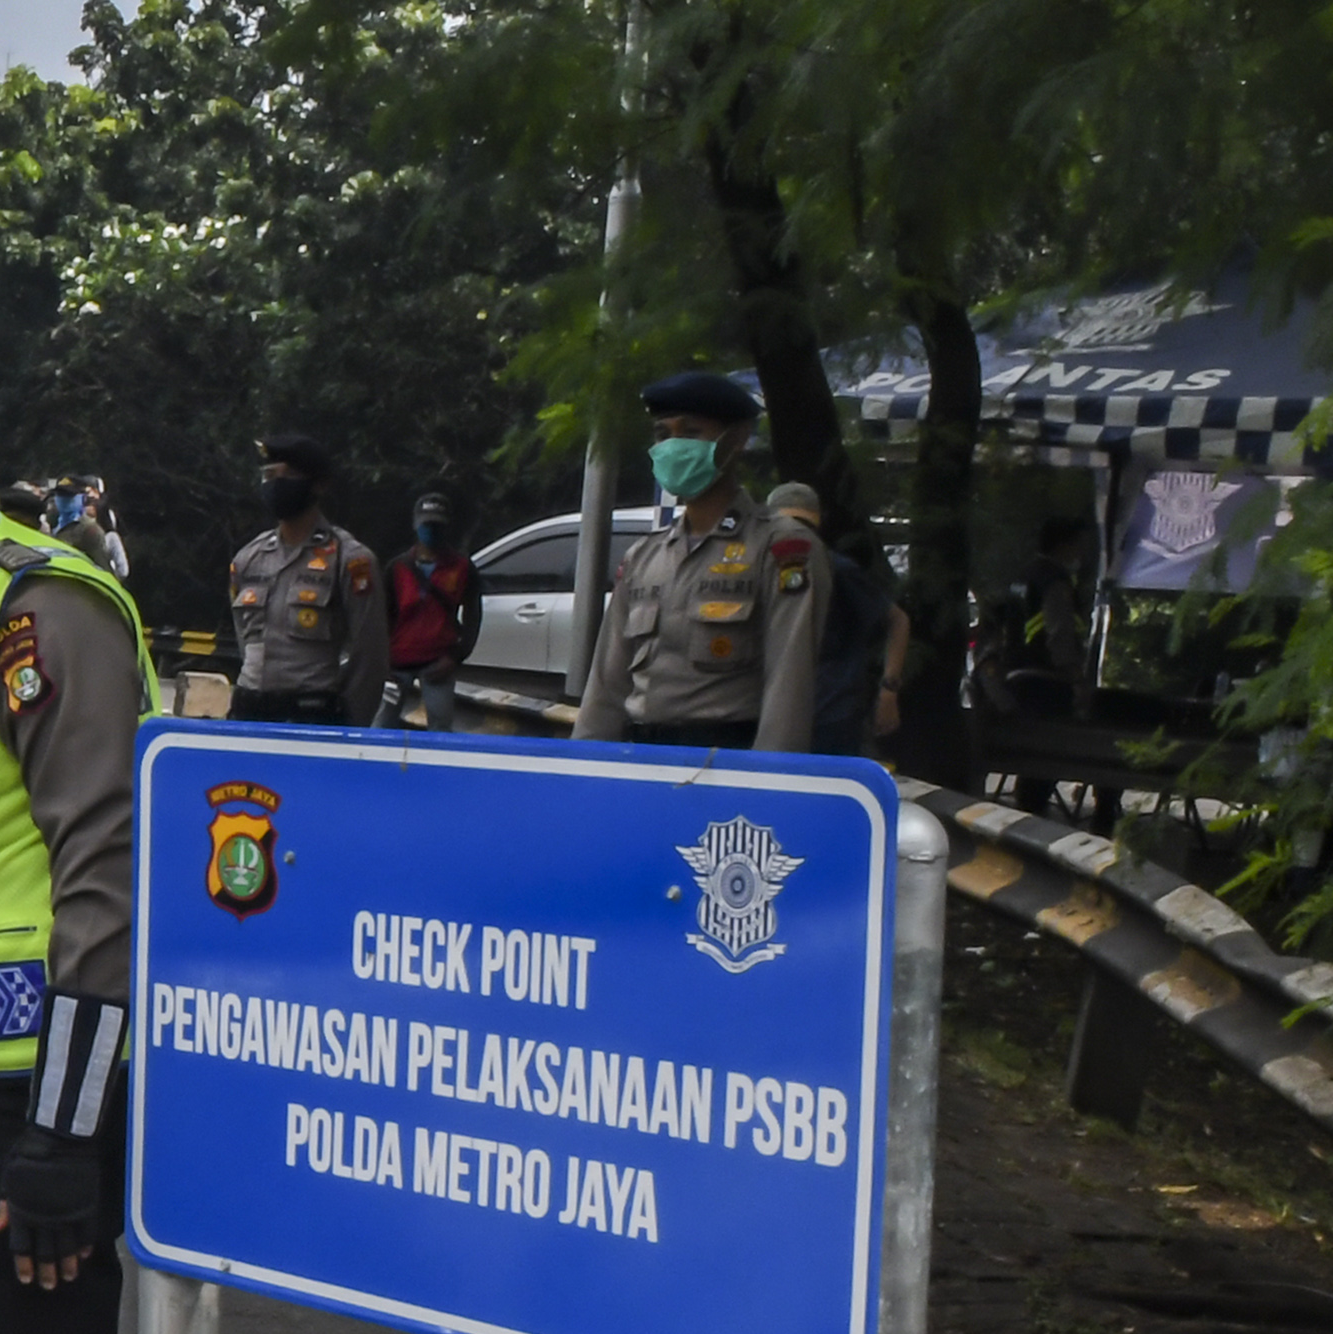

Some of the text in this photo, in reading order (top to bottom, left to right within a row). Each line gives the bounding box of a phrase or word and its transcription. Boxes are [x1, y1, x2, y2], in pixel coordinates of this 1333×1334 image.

[857, 362, 1231, 393] POANTAS
[353, 910, 596, 1010] CHECK POINT
[153, 983, 848, 1167] PENGAWASAN PELAKSANAAN PSBB
[286, 1103, 658, 1243] POLDA METRO JAYA
